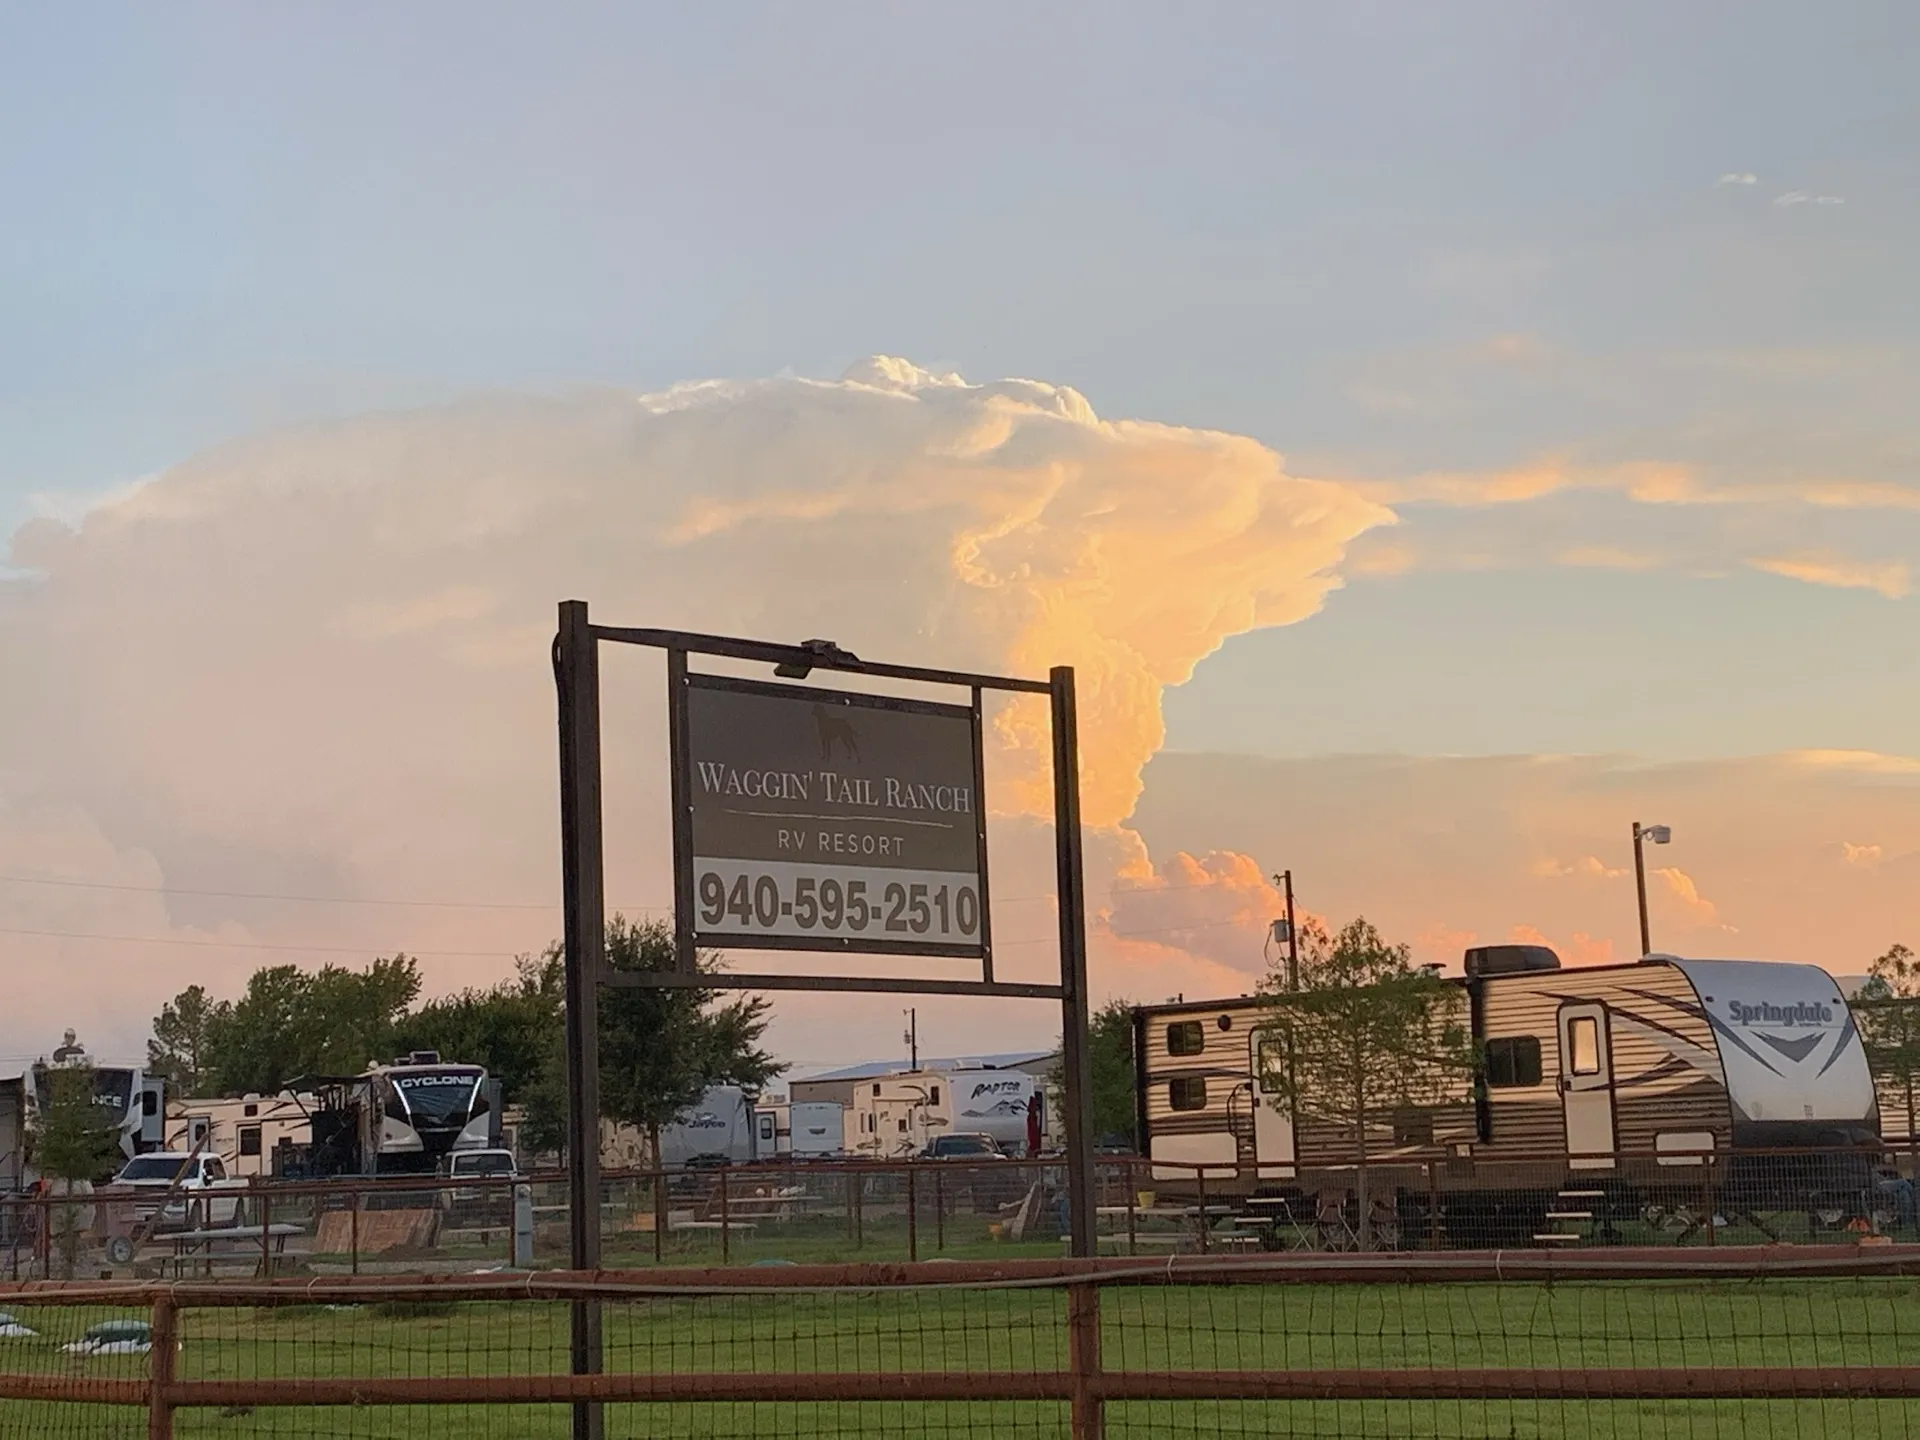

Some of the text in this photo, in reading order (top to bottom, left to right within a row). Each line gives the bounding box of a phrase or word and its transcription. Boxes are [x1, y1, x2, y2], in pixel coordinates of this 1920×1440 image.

[697, 761, 971, 814] WAGGIN' TAIL RANCH
[777, 829, 905, 856] RV RESORT
[699, 872, 978, 936] 940-595-2510
[1728, 1000, 1833, 1026] Springdale
[401, 1075, 474, 1088] CYCLONE
[970, 1081, 1021, 1100] RAPTOR
